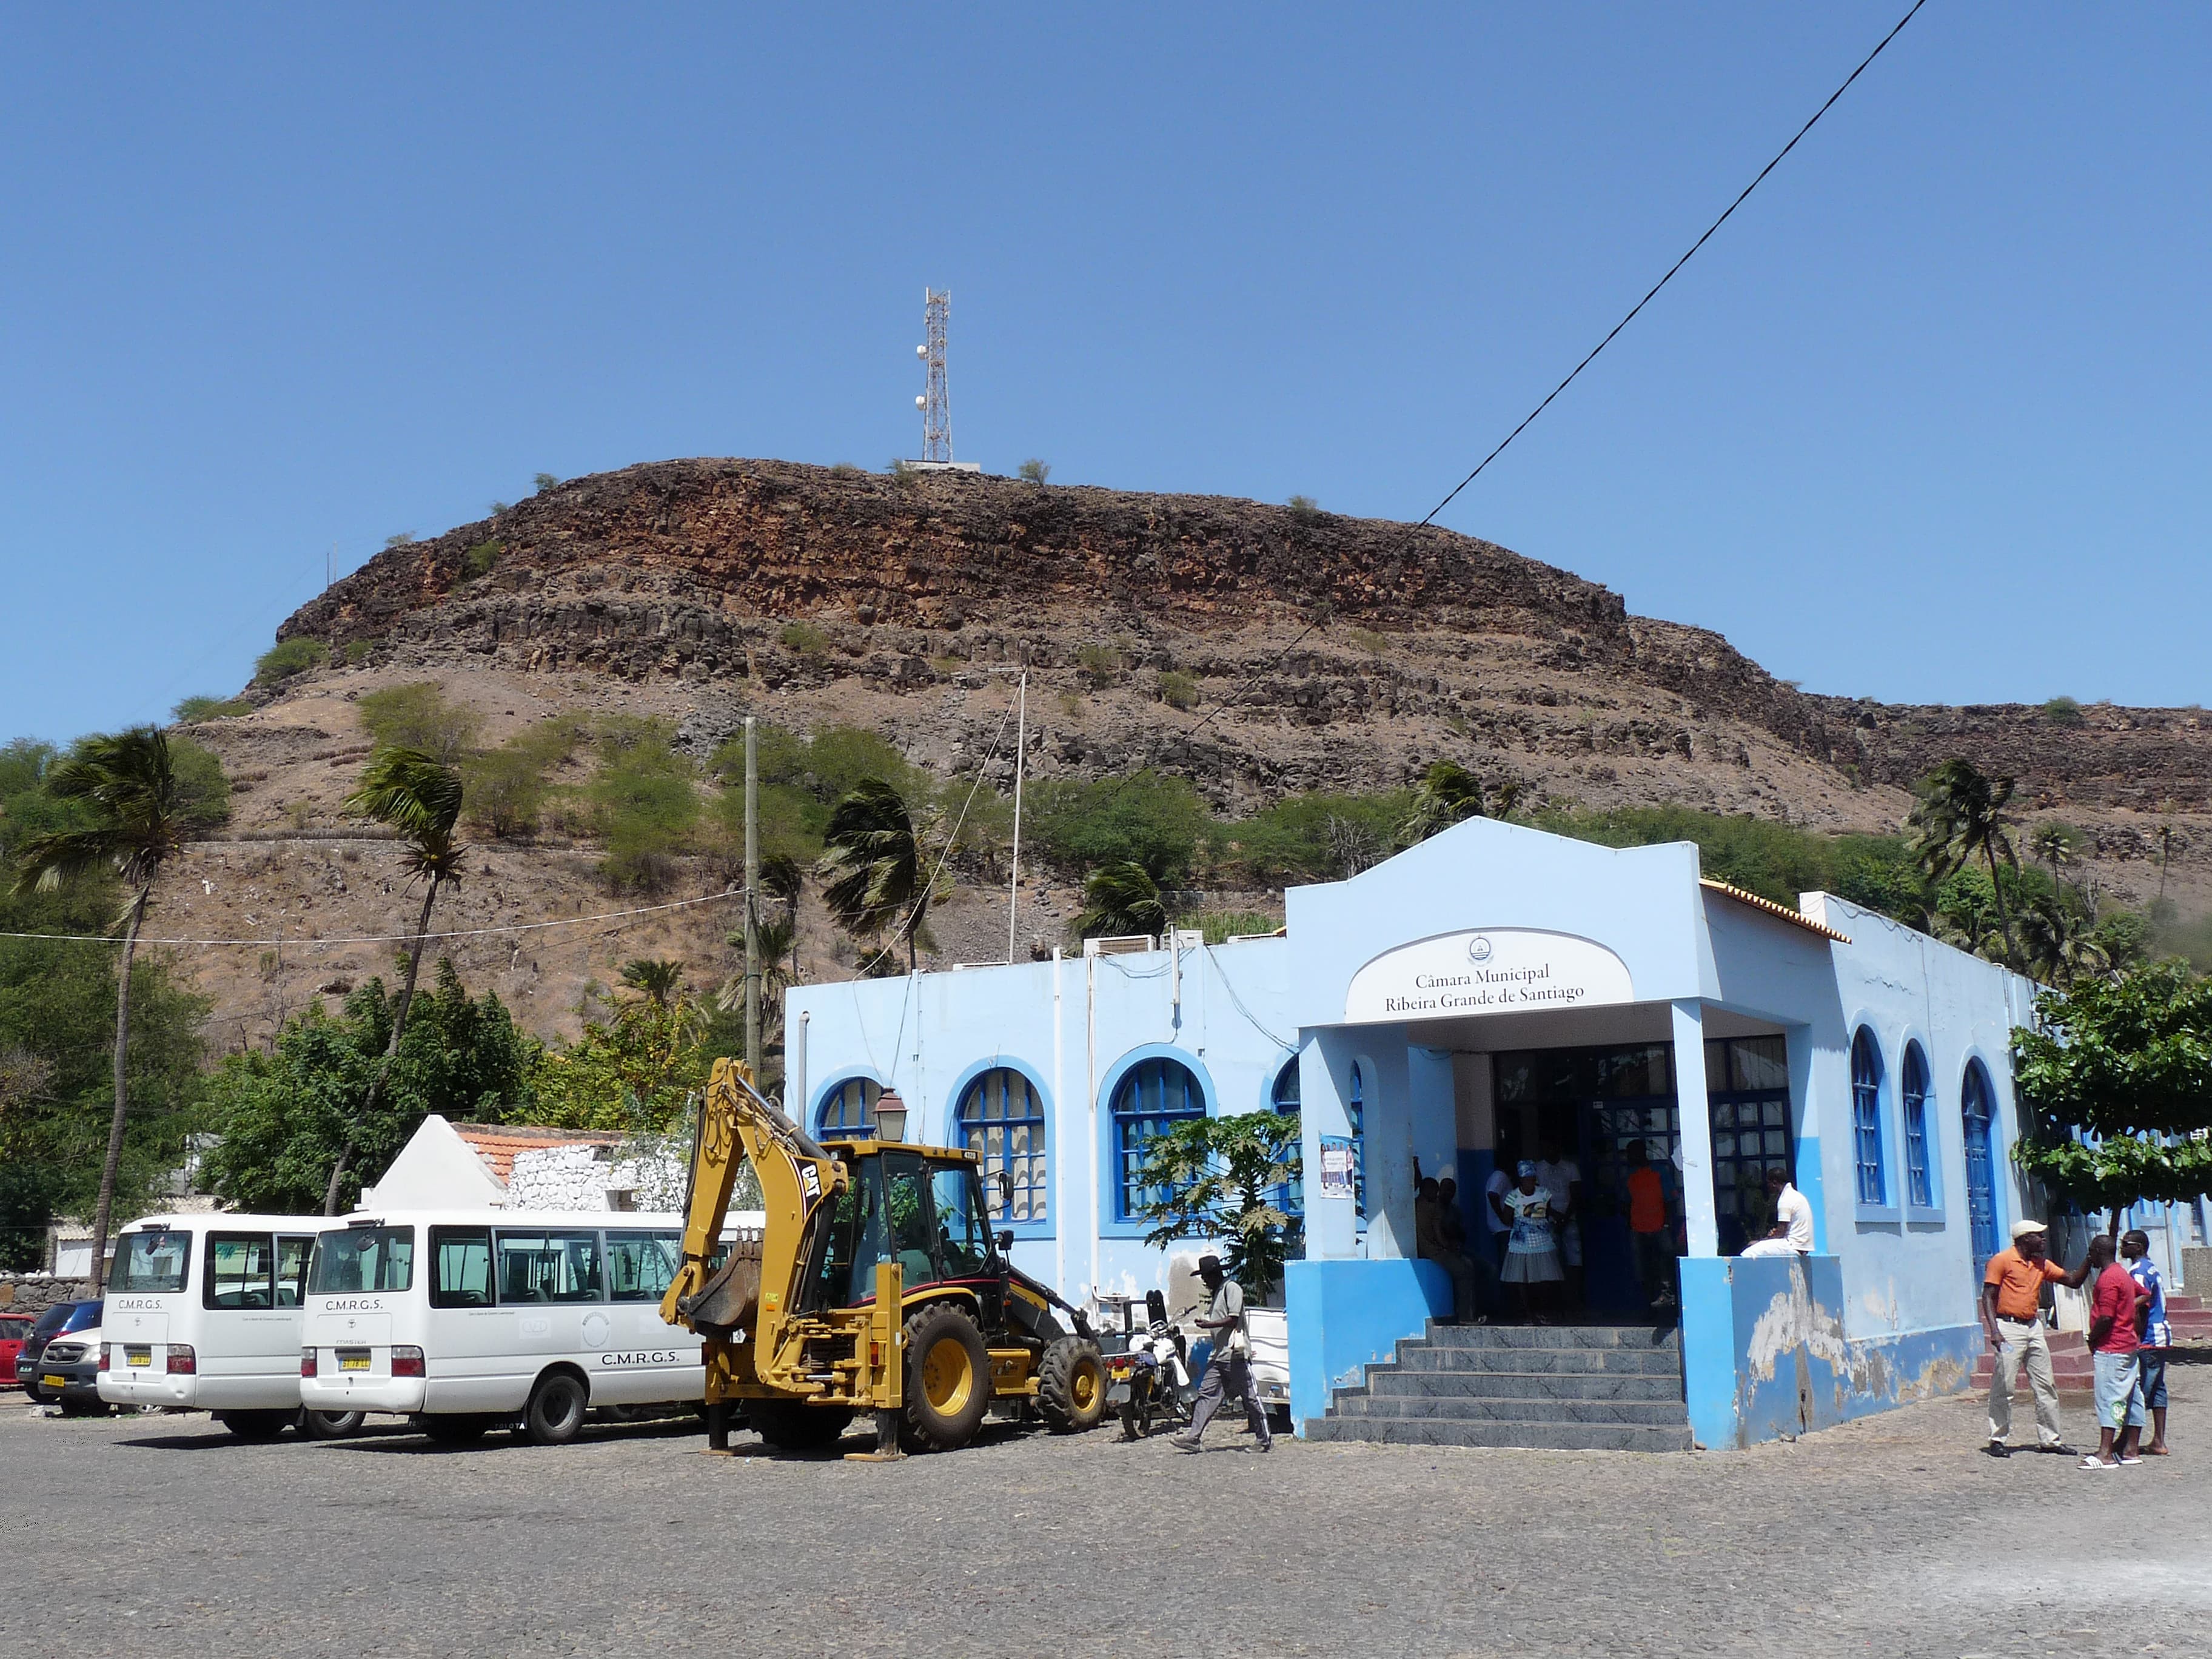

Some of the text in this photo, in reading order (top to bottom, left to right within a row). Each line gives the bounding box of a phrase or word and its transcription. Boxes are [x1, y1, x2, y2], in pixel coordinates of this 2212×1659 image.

[1415, 963, 1549, 988] Câmara Municipal
[1385, 985, 1584, 1011] Ribeira Grande de Santiago
[802, 1164, 820, 1198] CAT
[118, 1299, 163, 1309] C.M.R.G.S.
[326, 1299, 383, 1310] C.M.R.G.S.
[602, 1351, 680, 1365] C.M.R.G.S.
